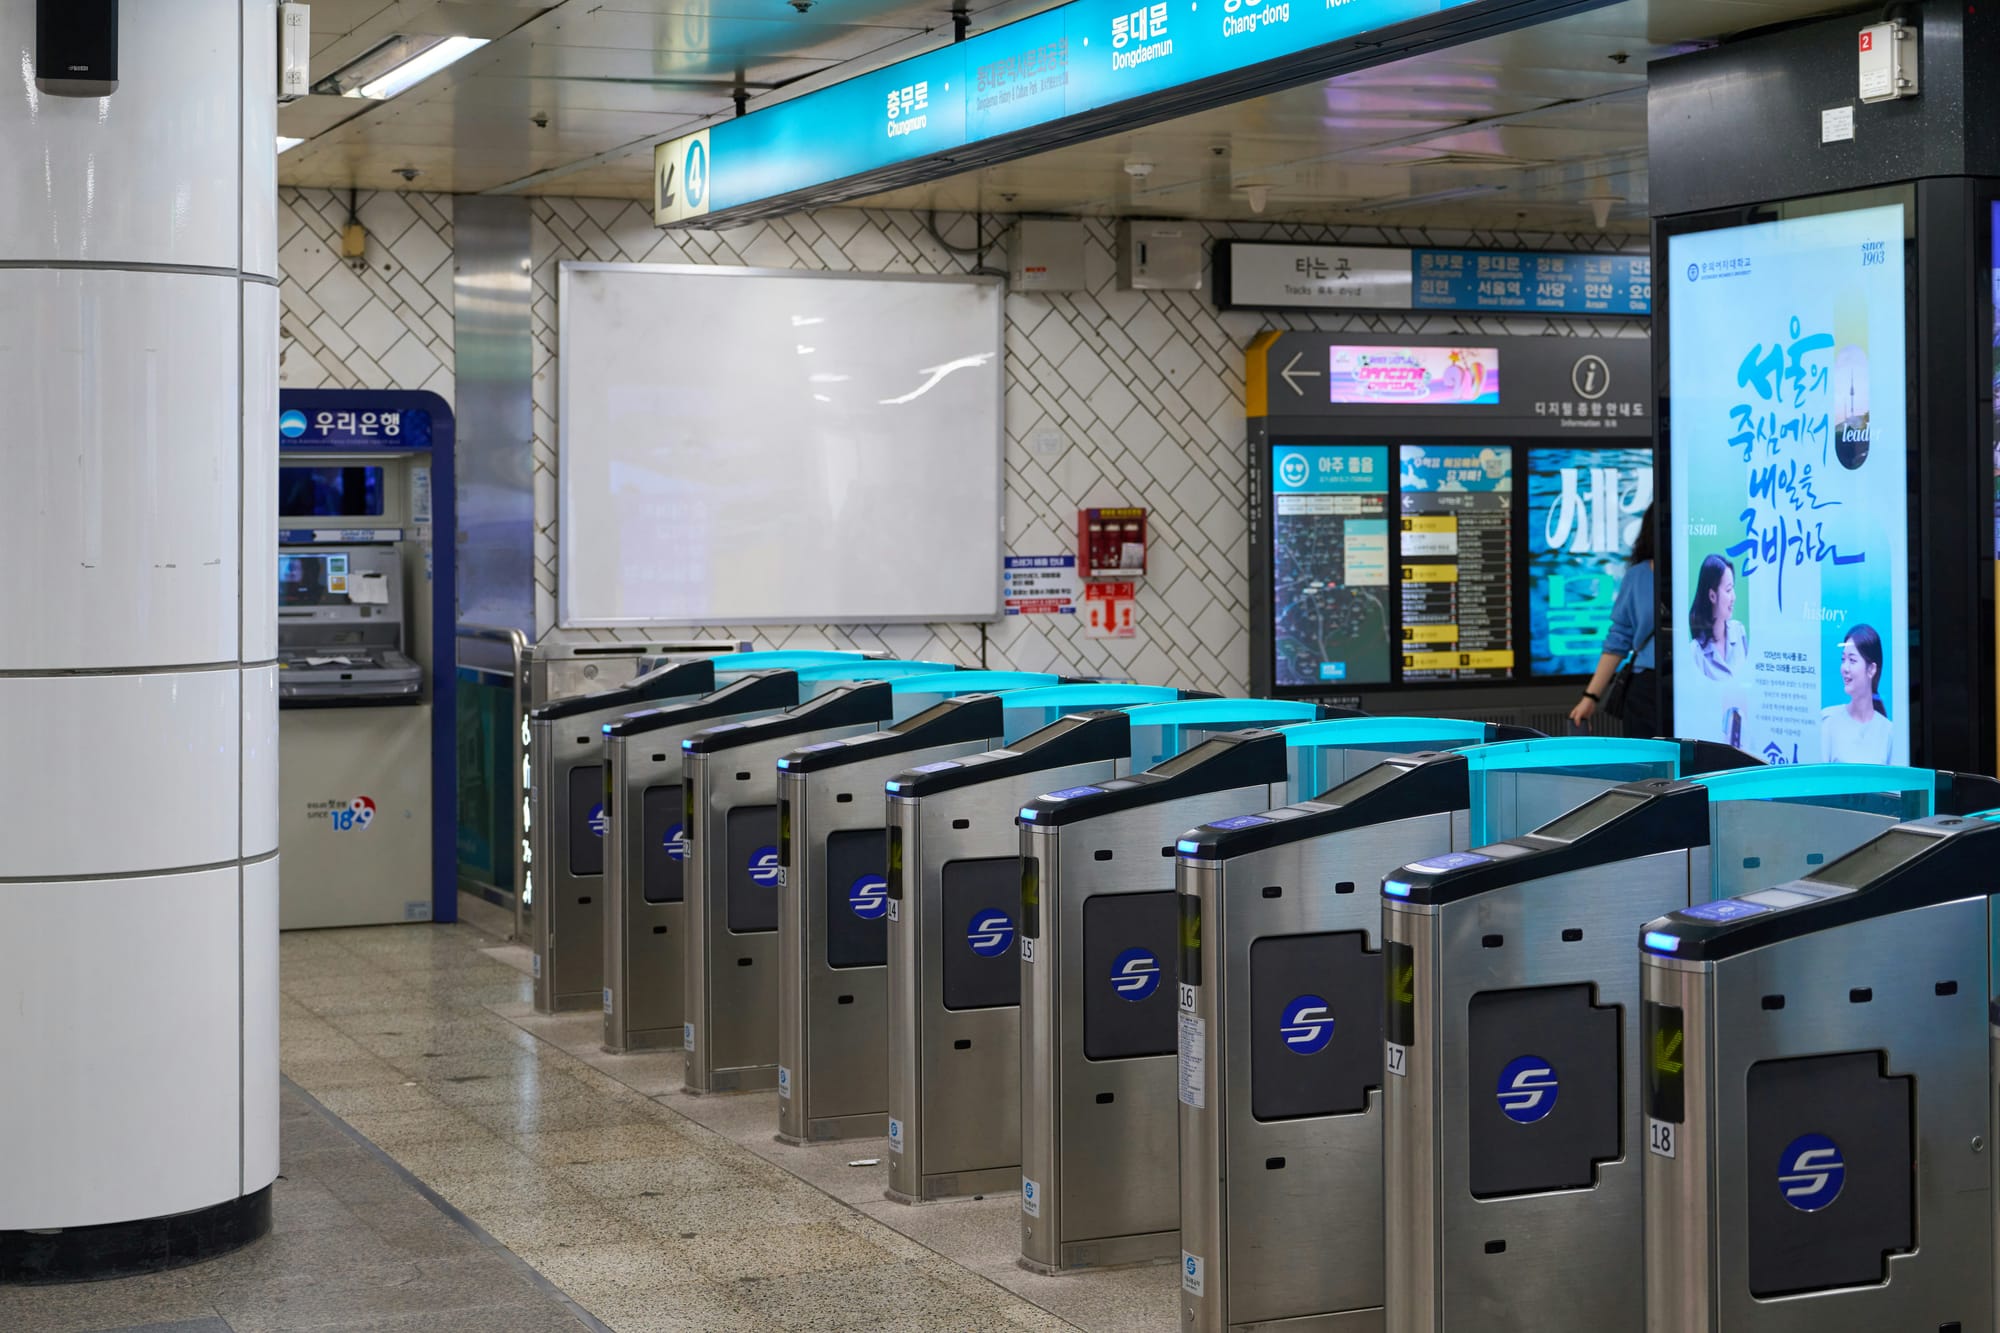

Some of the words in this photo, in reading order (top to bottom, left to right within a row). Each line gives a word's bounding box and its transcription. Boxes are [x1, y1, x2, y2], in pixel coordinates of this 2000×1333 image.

[1112, 1, 1169, 49] 동대문
[1223, 2, 1290, 38] Chang-dong
[1112, 38, 1173, 71] Dongdaemun
[1862, 35, 1870, 49] 2
[887, 80, 929, 120] 충무로
[887, 114, 927, 138] Chungmuro
[688, 146, 702, 200] 4
[1862, 238, 1885, 252] since
[1296, 256, 1330, 279] 타는
[1334, 257, 1352, 280] 곳
[1862, 251, 1886, 267] 1903
[1284, 284, 1312, 296] Tracks
[1478, 281, 1521, 296] 서울역
[1537, 283, 1566, 298] 사당
[1737, 314, 1836, 409] 서울의
[314, 411, 401, 437] 우리은행
[1728, 403, 1830, 467] 중심에서
[1748, 459, 1844, 511] 내일을
[1725, 507, 1865, 614] 준비하라
[887, 900, 897, 919] 14
[1022, 939, 1033, 959] 15
[1180, 986, 1194, 1008] 16
[1388, 1046, 1404, 1071] 17
[1652, 1123, 1672, 1153] 18
